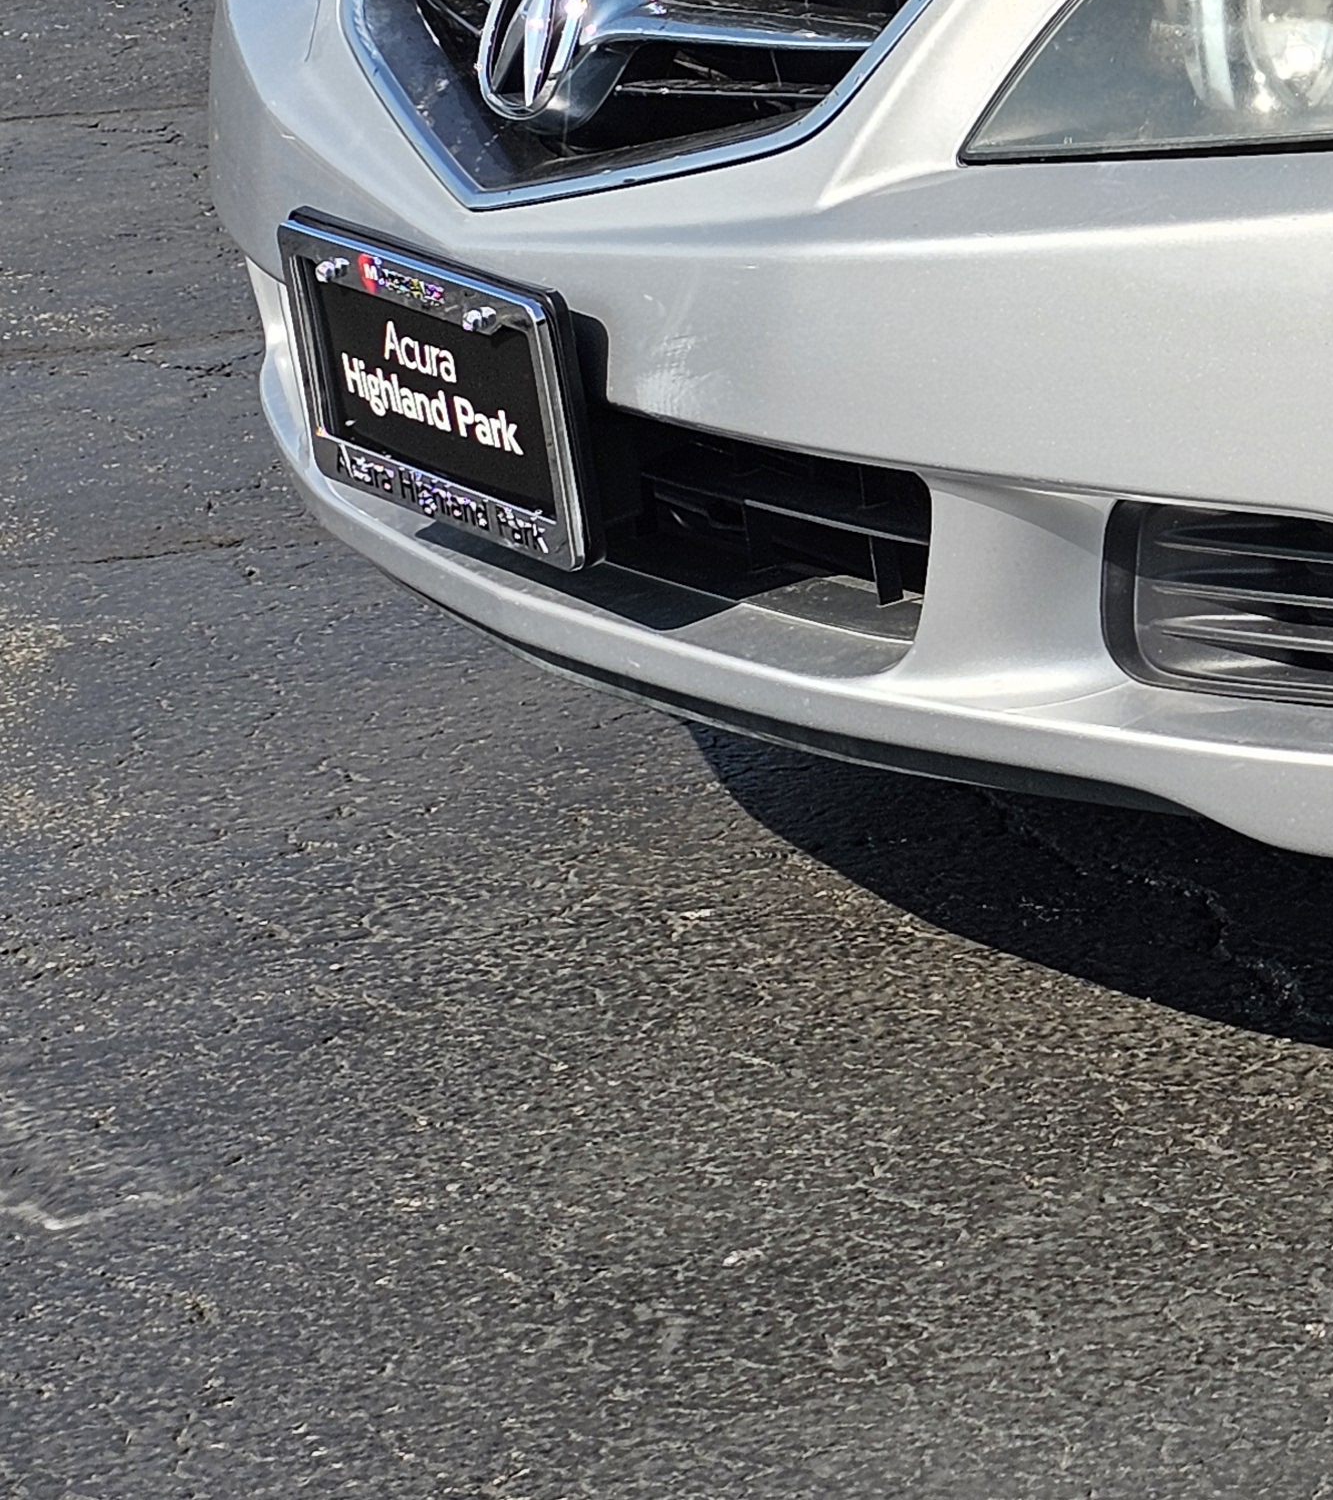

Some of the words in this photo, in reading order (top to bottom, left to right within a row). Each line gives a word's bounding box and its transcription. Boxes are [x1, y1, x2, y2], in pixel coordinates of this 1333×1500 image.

[384, 320, 457, 384] Acura
[341, 352, 452, 432] Highland
[453, 395, 524, 456] Park
